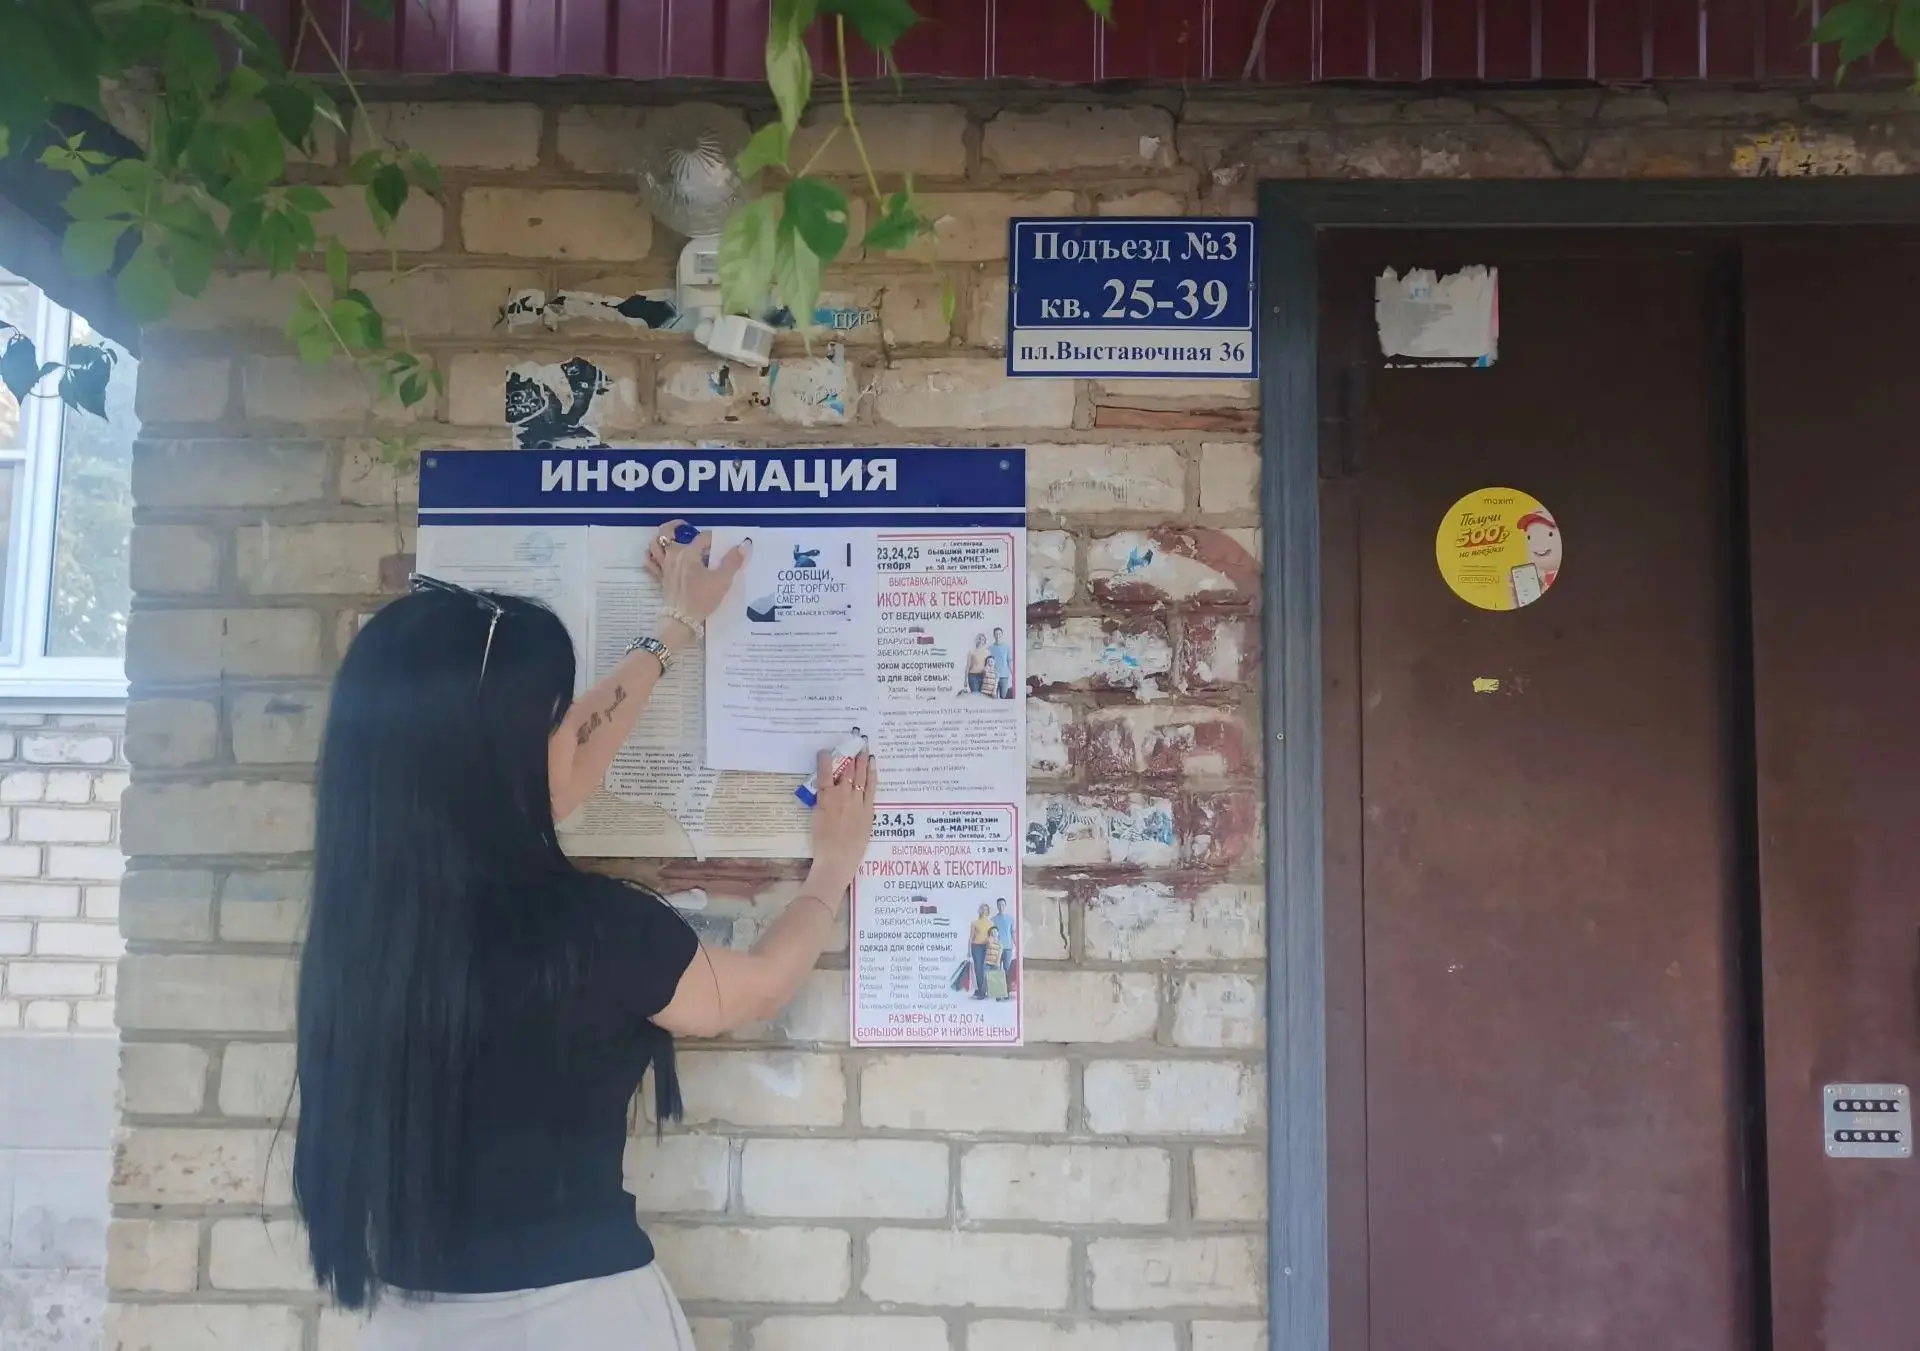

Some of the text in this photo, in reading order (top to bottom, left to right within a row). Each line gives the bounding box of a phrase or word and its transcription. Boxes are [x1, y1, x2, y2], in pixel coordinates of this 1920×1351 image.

[1033, 231, 1237, 263] Подъезд №3
[1040, 278, 1228, 320] кв. 25-39
[1021, 341, 1245, 362] пл.Выставочная 36
[541, 458, 897, 498] ИНФОРМАЦИЯ
[1483, 497, 1514, 505] maxim
[1460, 512, 1501, 527] Получи
[928, 548, 962, 556] бывший
[778, 570, 834, 582] СООБЩИ,
[889, 576, 968, 588] ВЫСТАВКА-ПРОДАЖА
[777, 583, 846, 594] ГДЕ ТОРГУЮТ
[777, 595, 820, 604] СМЕРТЬЮ
[930, 591, 938, 607] &
[941, 590, 1009, 607] ТЕКСТИЛЬ»
[881, 611, 984, 622] ОТ ВЕДУЩИХ ФАБРИК:
[901, 662, 955, 671] ассортименте
[904, 674, 921, 682] всей
[891, 845, 972, 856] ВЫСТАВКА-ПРОДАЖА
[858, 859, 1013, 877] «ТРИКОТАЖ & ТЕКСТИЛЬ»
[883, 880, 988, 891] ОТ ВЕДУЩИХ ФАБРИК:
[874, 907, 918, 915] БЕЛАРУСИ
[875, 918, 932, 927] УЗБЕКИСТАНА
[859, 930, 958, 941] В широком ассортименте
[859, 944, 889, 953] одежда
[906, 943, 924, 952] всей
[926, 944, 953, 952] семьи:
[888, 1013, 985, 1025] РАЗМЕРЫ ОТ 42 ДО 74
[857, 1026, 904, 1038] БОЛЬШОЙ
[906, 1027, 939, 1037] ВЫБОР
[941, 1027, 948, 1037] И
[950, 1026, 984, 1037] НИЗКИЕ
